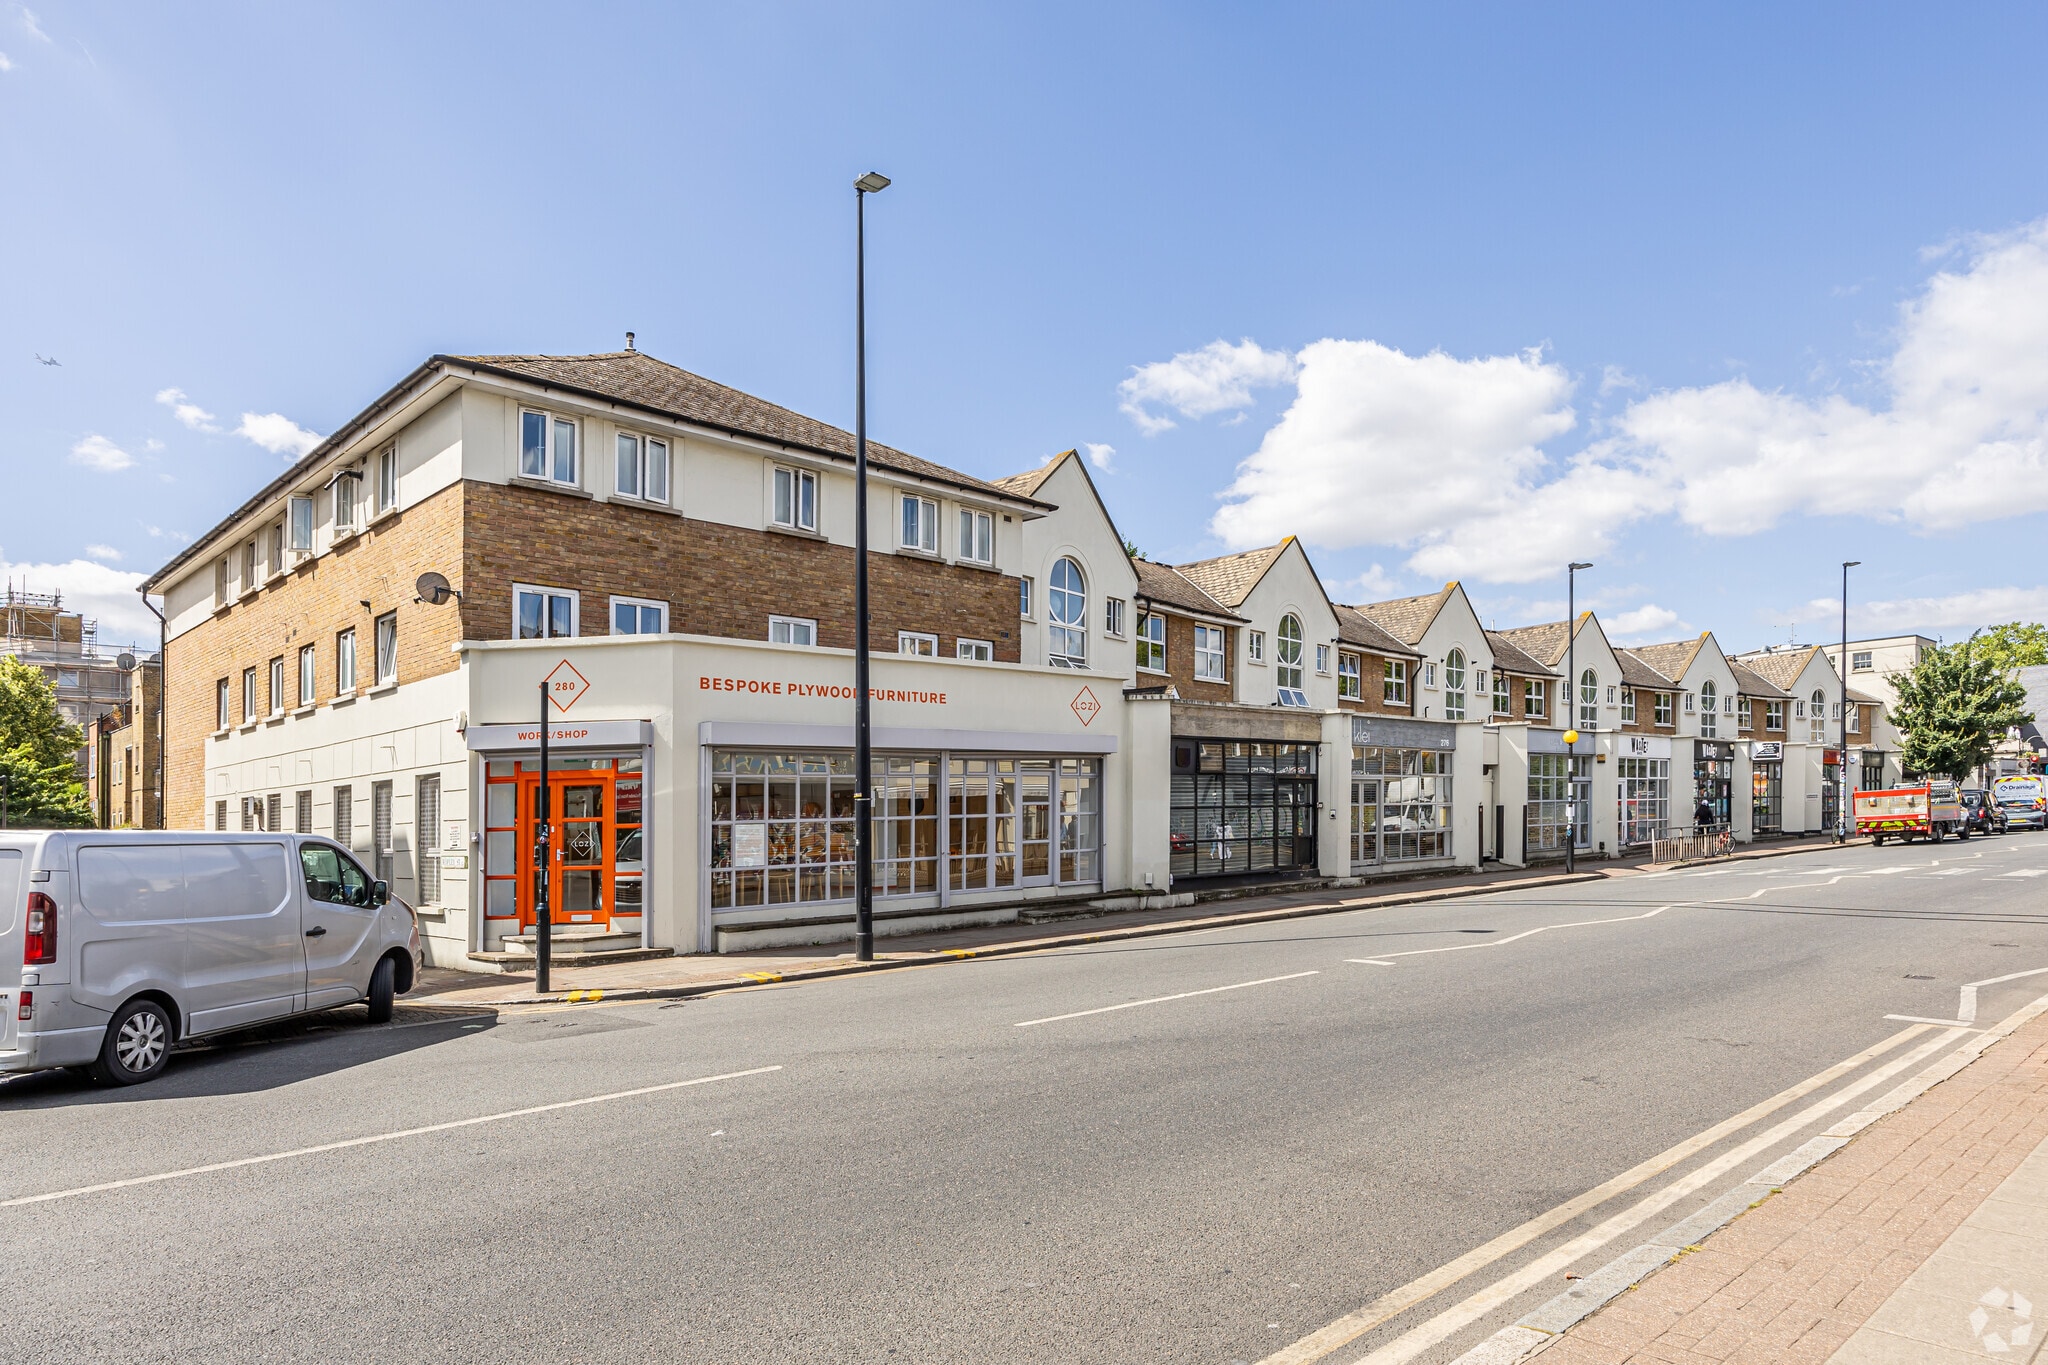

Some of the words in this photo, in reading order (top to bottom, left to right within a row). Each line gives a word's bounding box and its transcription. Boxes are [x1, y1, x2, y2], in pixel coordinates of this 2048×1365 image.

[555, 682, 575, 691] 280
[699, 677, 782, 695] BESPOKE
[867, 688, 947, 704] FURNITURE
[1075, 701, 1096, 711] LOZI
